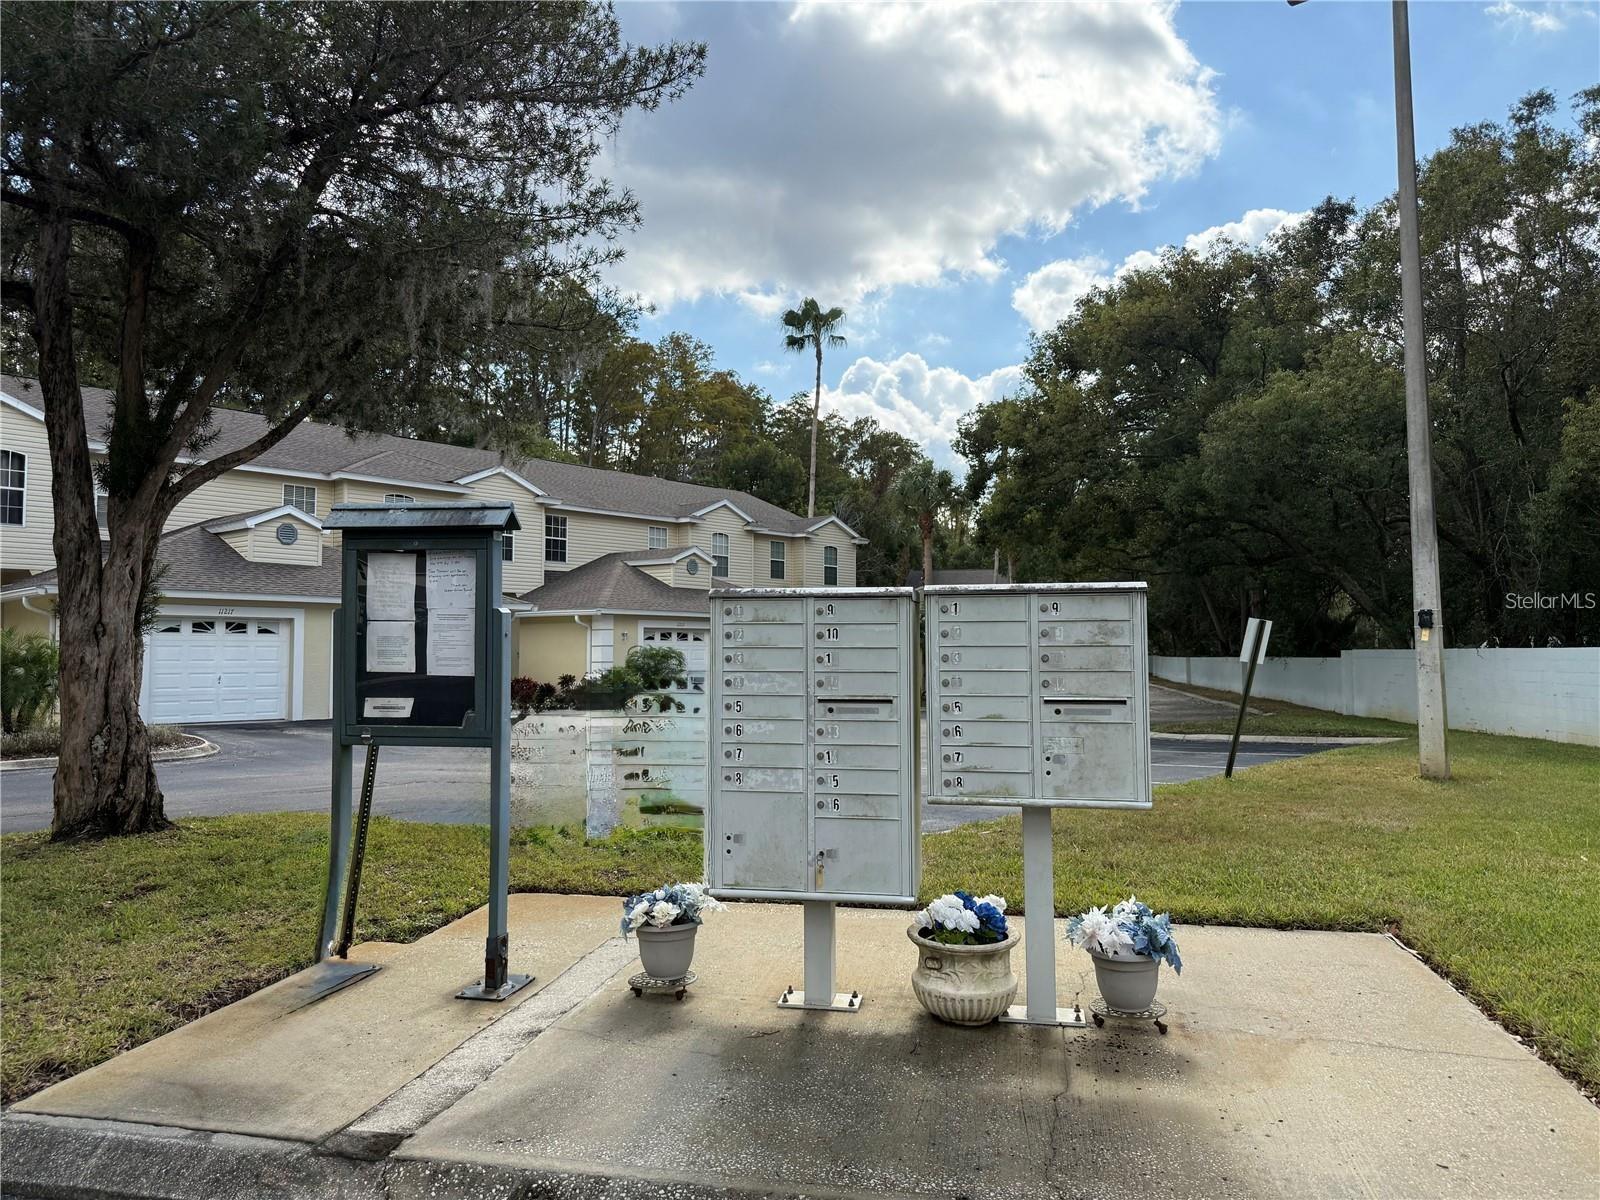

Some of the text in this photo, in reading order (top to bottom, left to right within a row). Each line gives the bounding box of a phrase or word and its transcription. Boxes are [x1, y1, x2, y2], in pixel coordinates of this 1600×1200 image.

[827, 603, 834, 616] 9
[952, 602, 958, 616] 1
[1052, 602, 1058, 614] 9
[736, 700, 742, 713] 5
[954, 701, 960, 713] 5
[736, 724, 742, 736] 6
[954, 725, 961, 736] 6
[736, 748, 742, 760] 7
[954, 752, 960, 762] 7
[956, 776, 962, 788] 8
